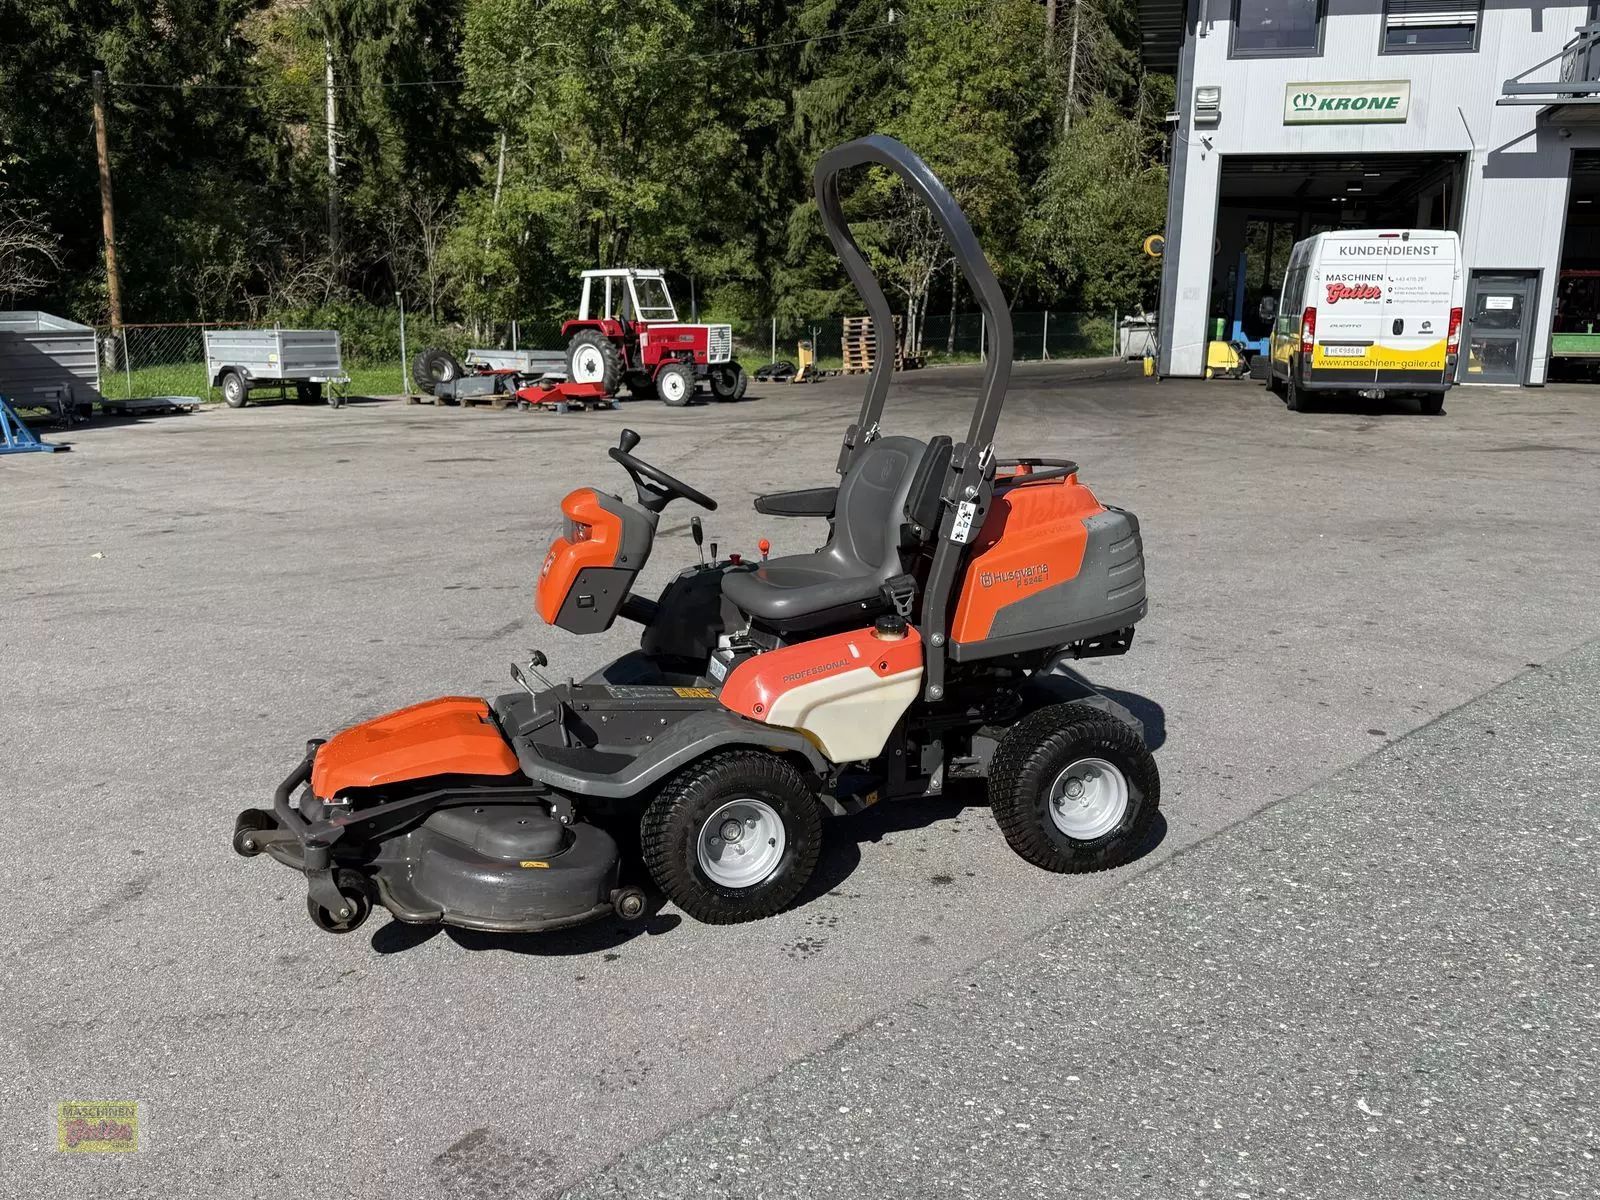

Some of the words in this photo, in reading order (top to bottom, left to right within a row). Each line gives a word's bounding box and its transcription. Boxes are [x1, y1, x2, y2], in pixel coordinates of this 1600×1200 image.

[1317, 96, 1401, 111] KRONE
[1339, 246, 1439, 256] KUNDENDIENST
[1326, 274, 1384, 282] MASCHINEN
[1326, 282, 1382, 304] Gailer
[1318, 359, 1440, 369] www.maschinen-gailer.at
[993, 563, 1049, 584] Husqvarna
[782, 659, 851, 683] PROFESSIONAL
